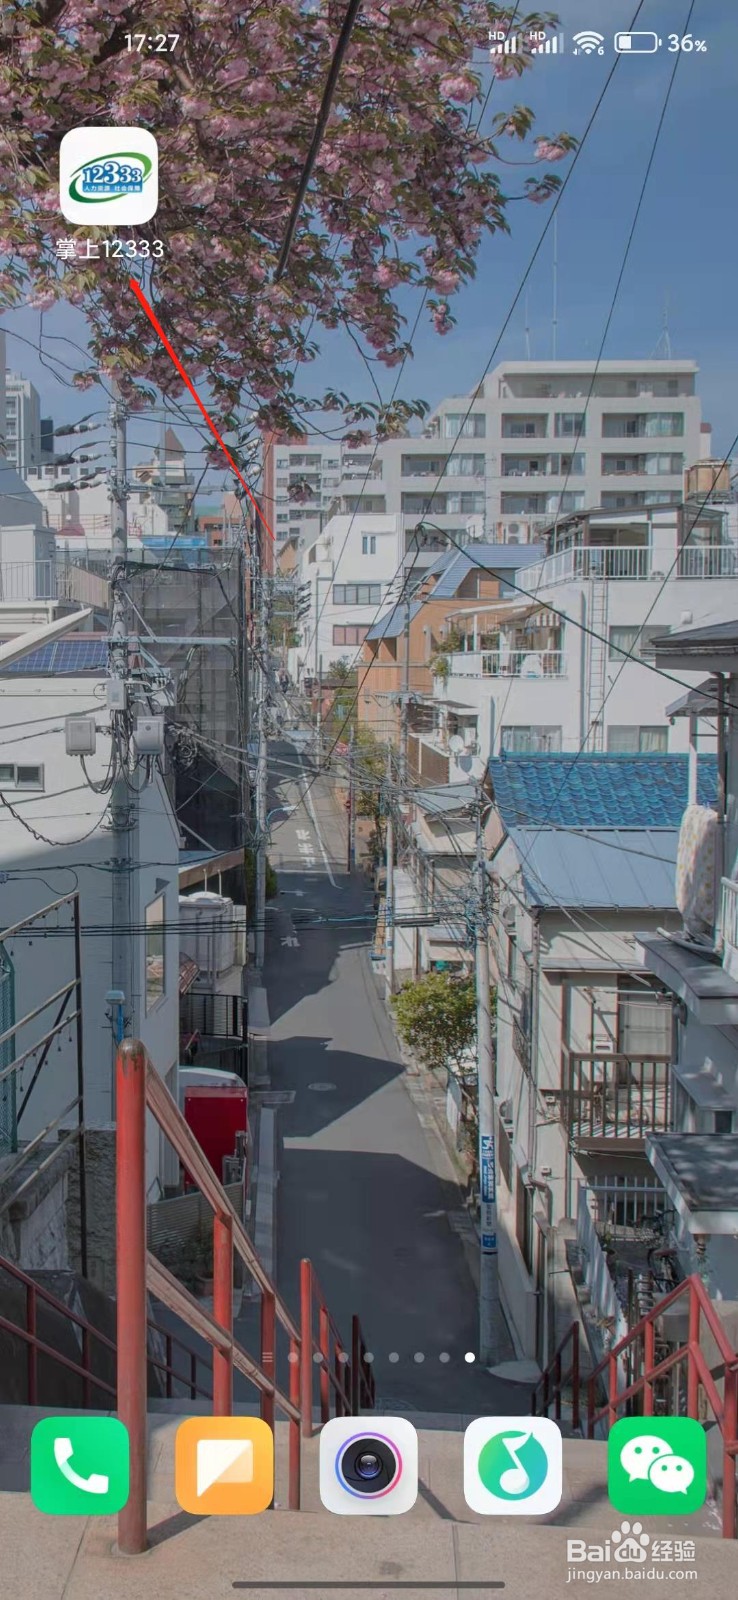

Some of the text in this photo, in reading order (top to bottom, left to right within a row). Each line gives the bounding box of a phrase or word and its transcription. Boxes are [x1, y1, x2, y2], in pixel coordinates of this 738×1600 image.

[124, 34, 179, 52] 17:27
[488, 32, 505, 41] HD
[529, 32, 546, 41] HD
[667, 34, 707, 52] 36%
[83, 162, 142, 185] 12333
[55, 237, 164, 260] 掌上12333
